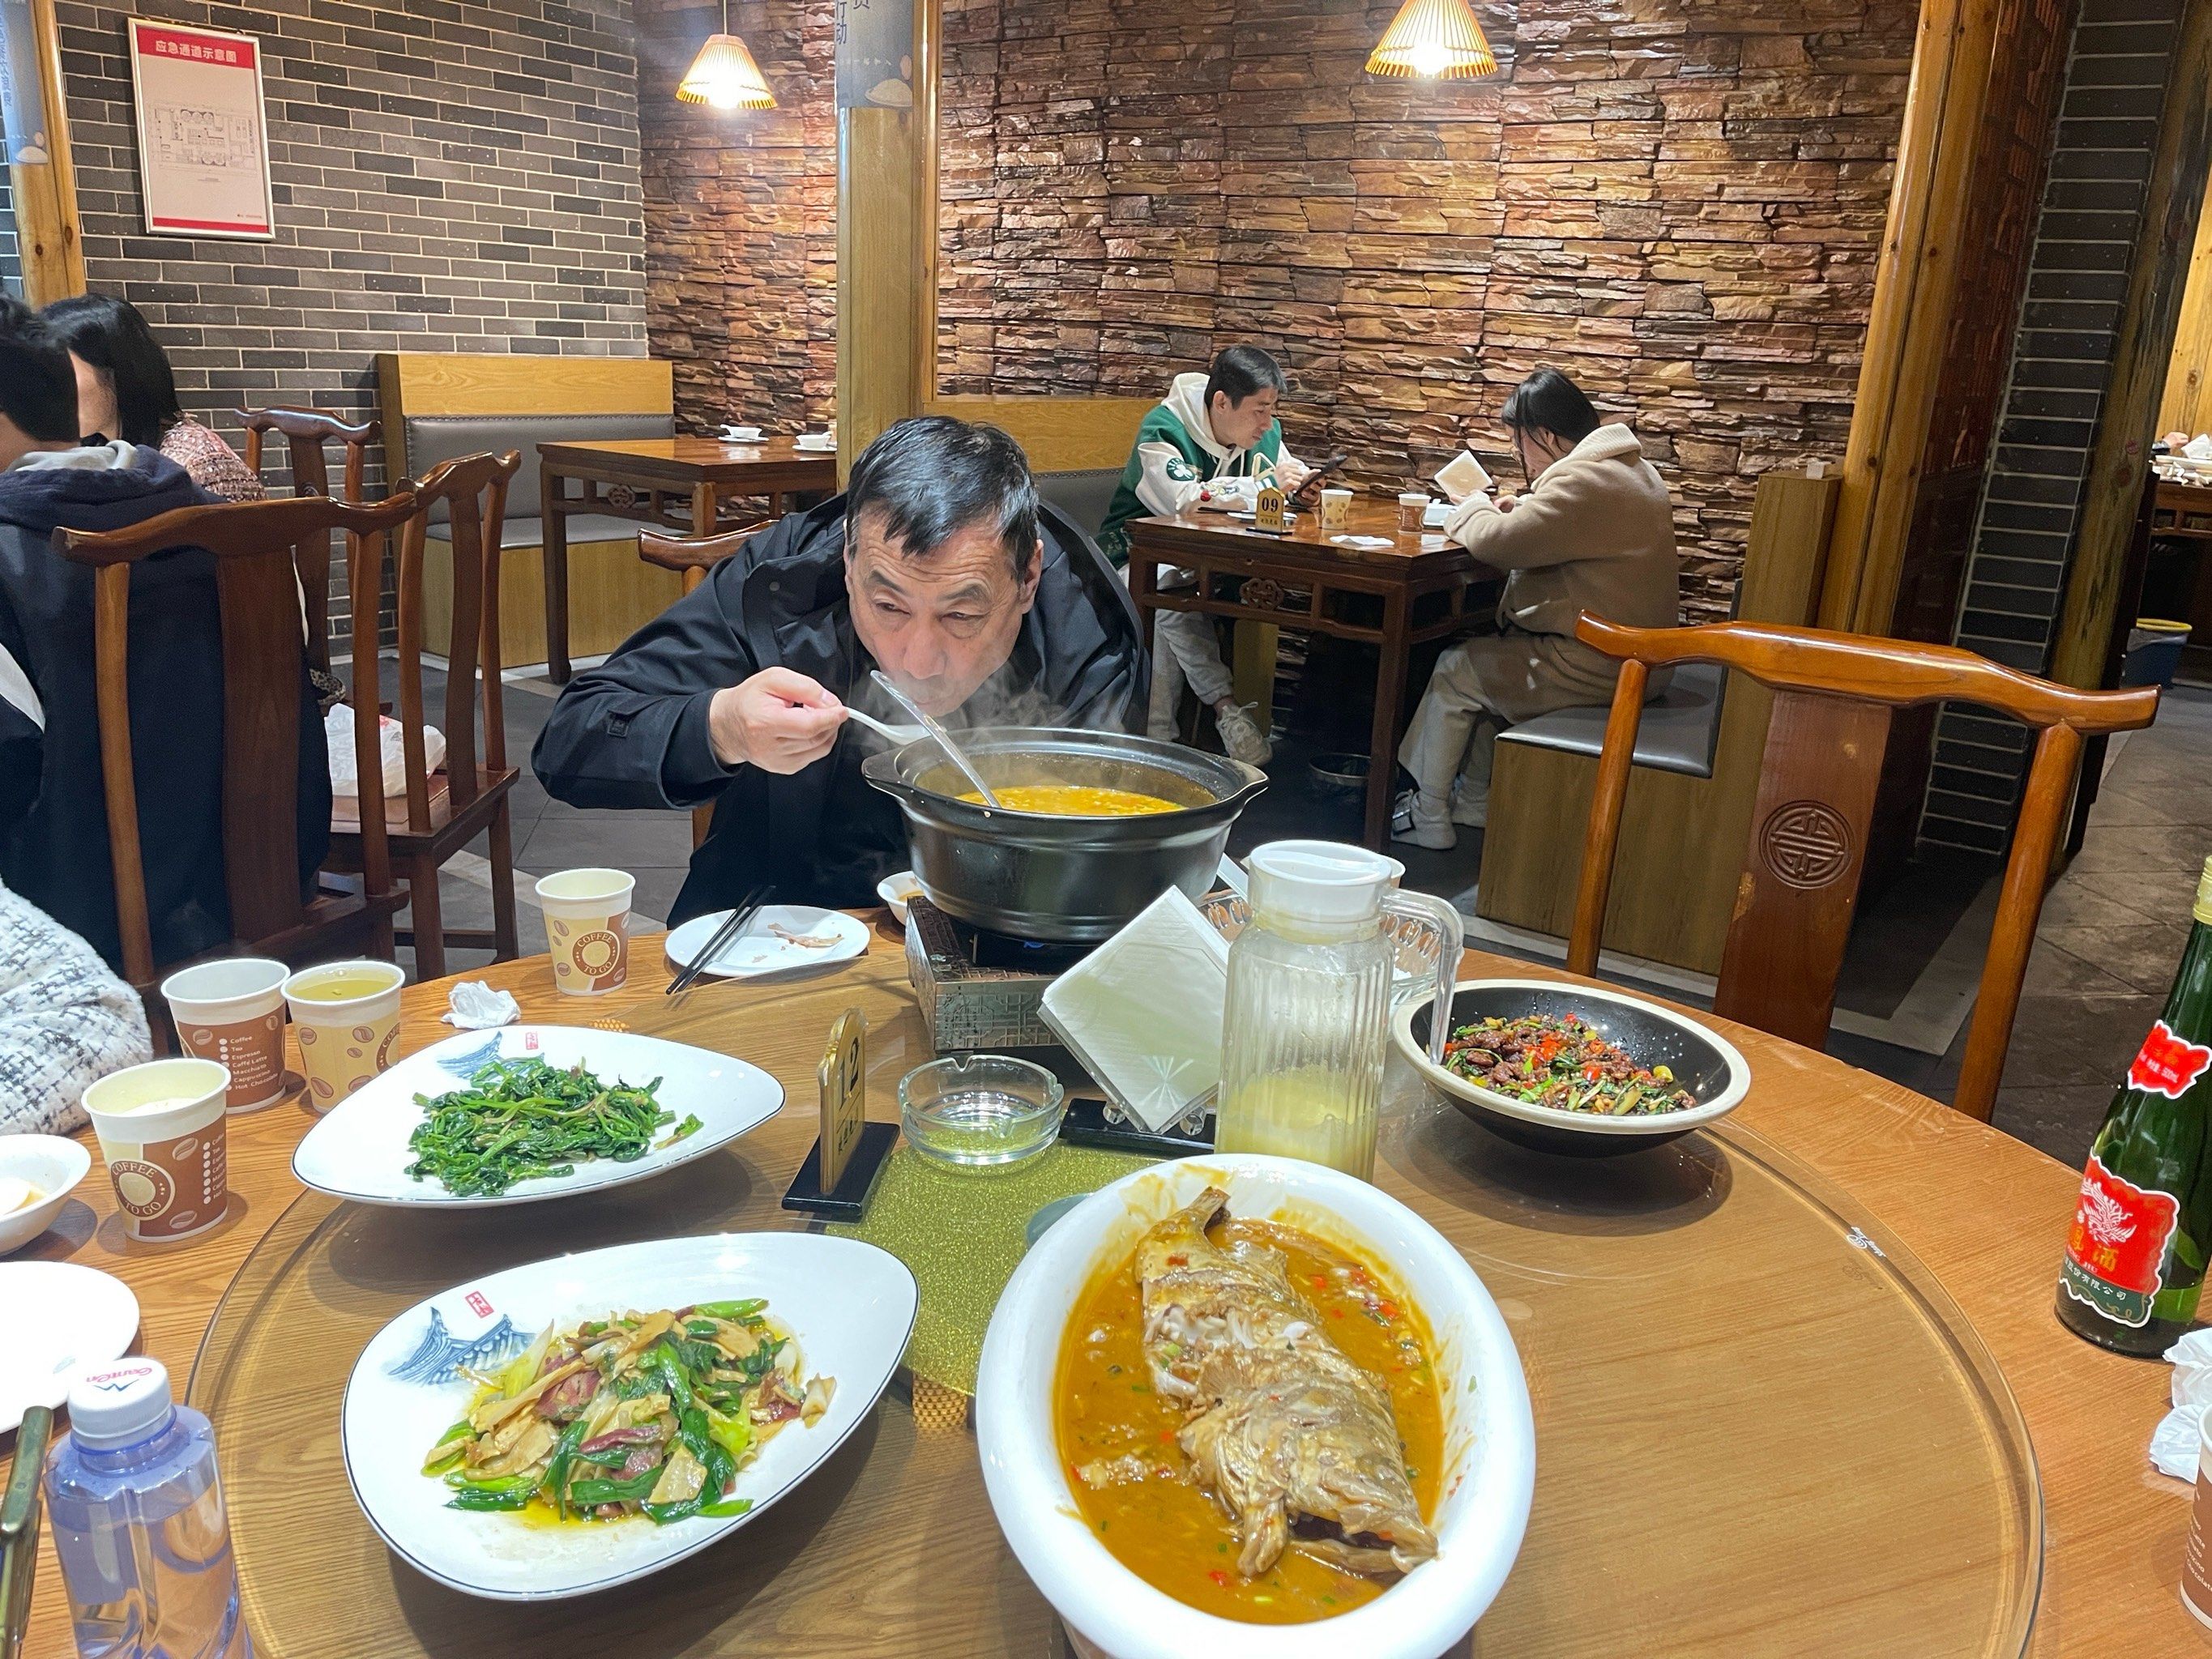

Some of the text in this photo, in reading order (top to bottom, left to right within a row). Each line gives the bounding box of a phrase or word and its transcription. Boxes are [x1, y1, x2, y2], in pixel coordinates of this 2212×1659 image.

[1262, 497, 1279, 513] 09
[577, 932, 614, 975] COFFEE TO GO
[230, 1036, 253, 1044] Coffee
[232, 1050, 261, 1060] Espresso
[839, 1037, 859, 1111] 12
[112, 1162, 162, 1215] COFFEE TO GO
